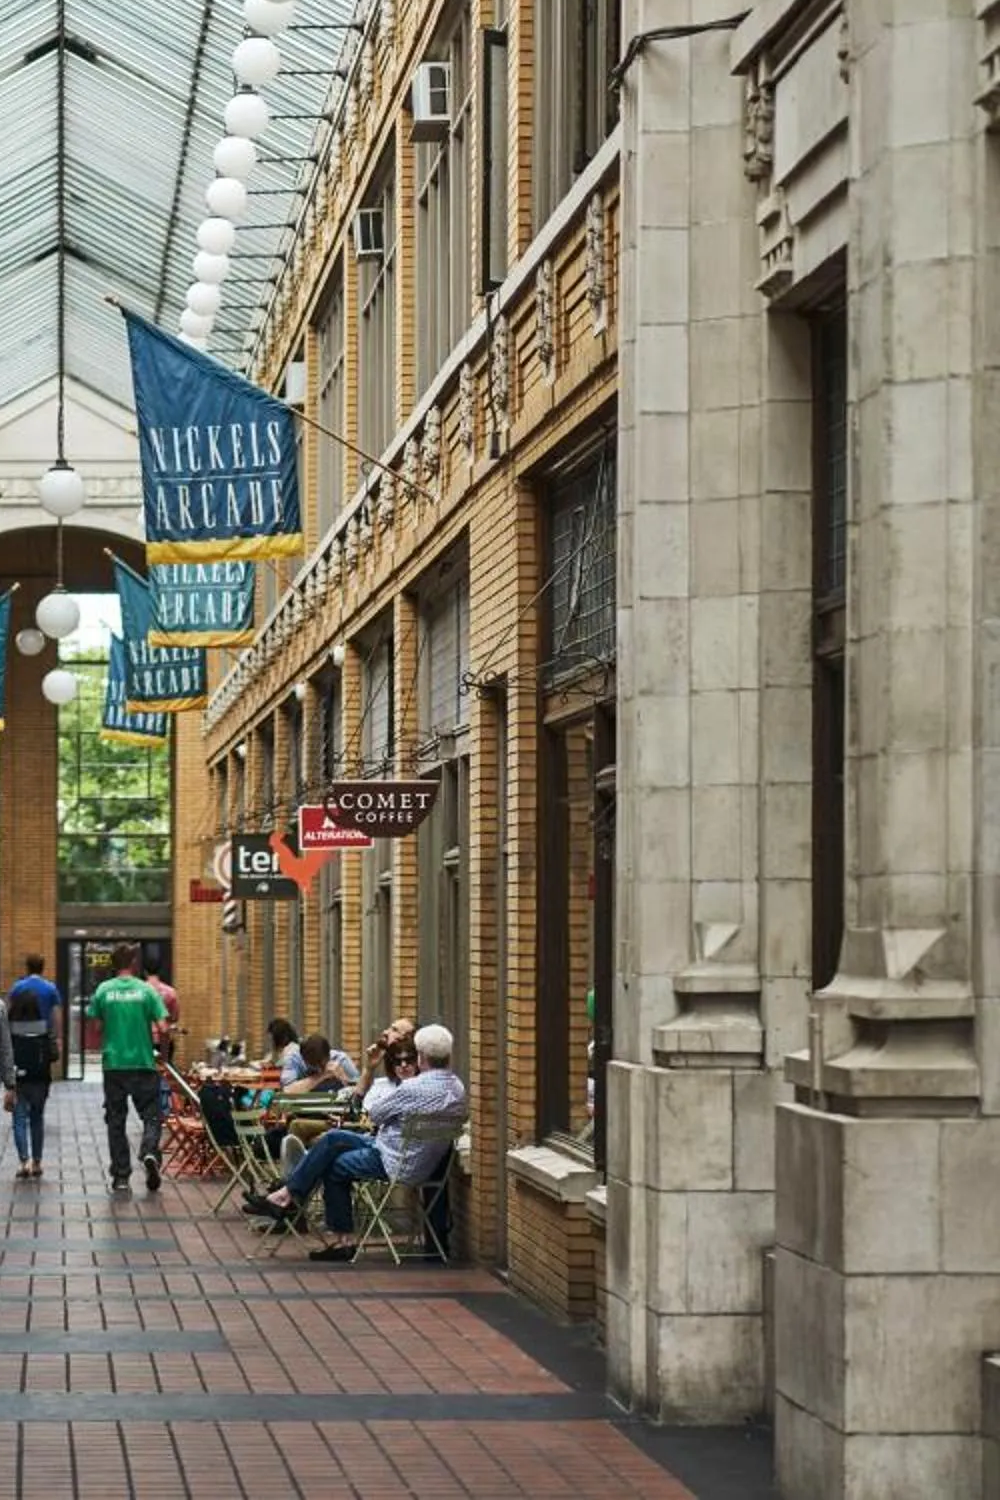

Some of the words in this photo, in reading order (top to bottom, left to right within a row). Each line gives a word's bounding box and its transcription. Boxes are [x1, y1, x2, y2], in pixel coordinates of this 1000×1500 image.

[150, 421, 281, 473] NICKELS
[156, 479, 285, 530] ARCADE
[156, 561, 246, 584] NICKELS
[157, 591, 248, 625] ARCADE
[133, 666, 201, 695] ARCADE
[339, 793, 431, 809] COMET
[355, 811, 414, 823] COFFEE
[304, 829, 368, 841] ALTERATION
